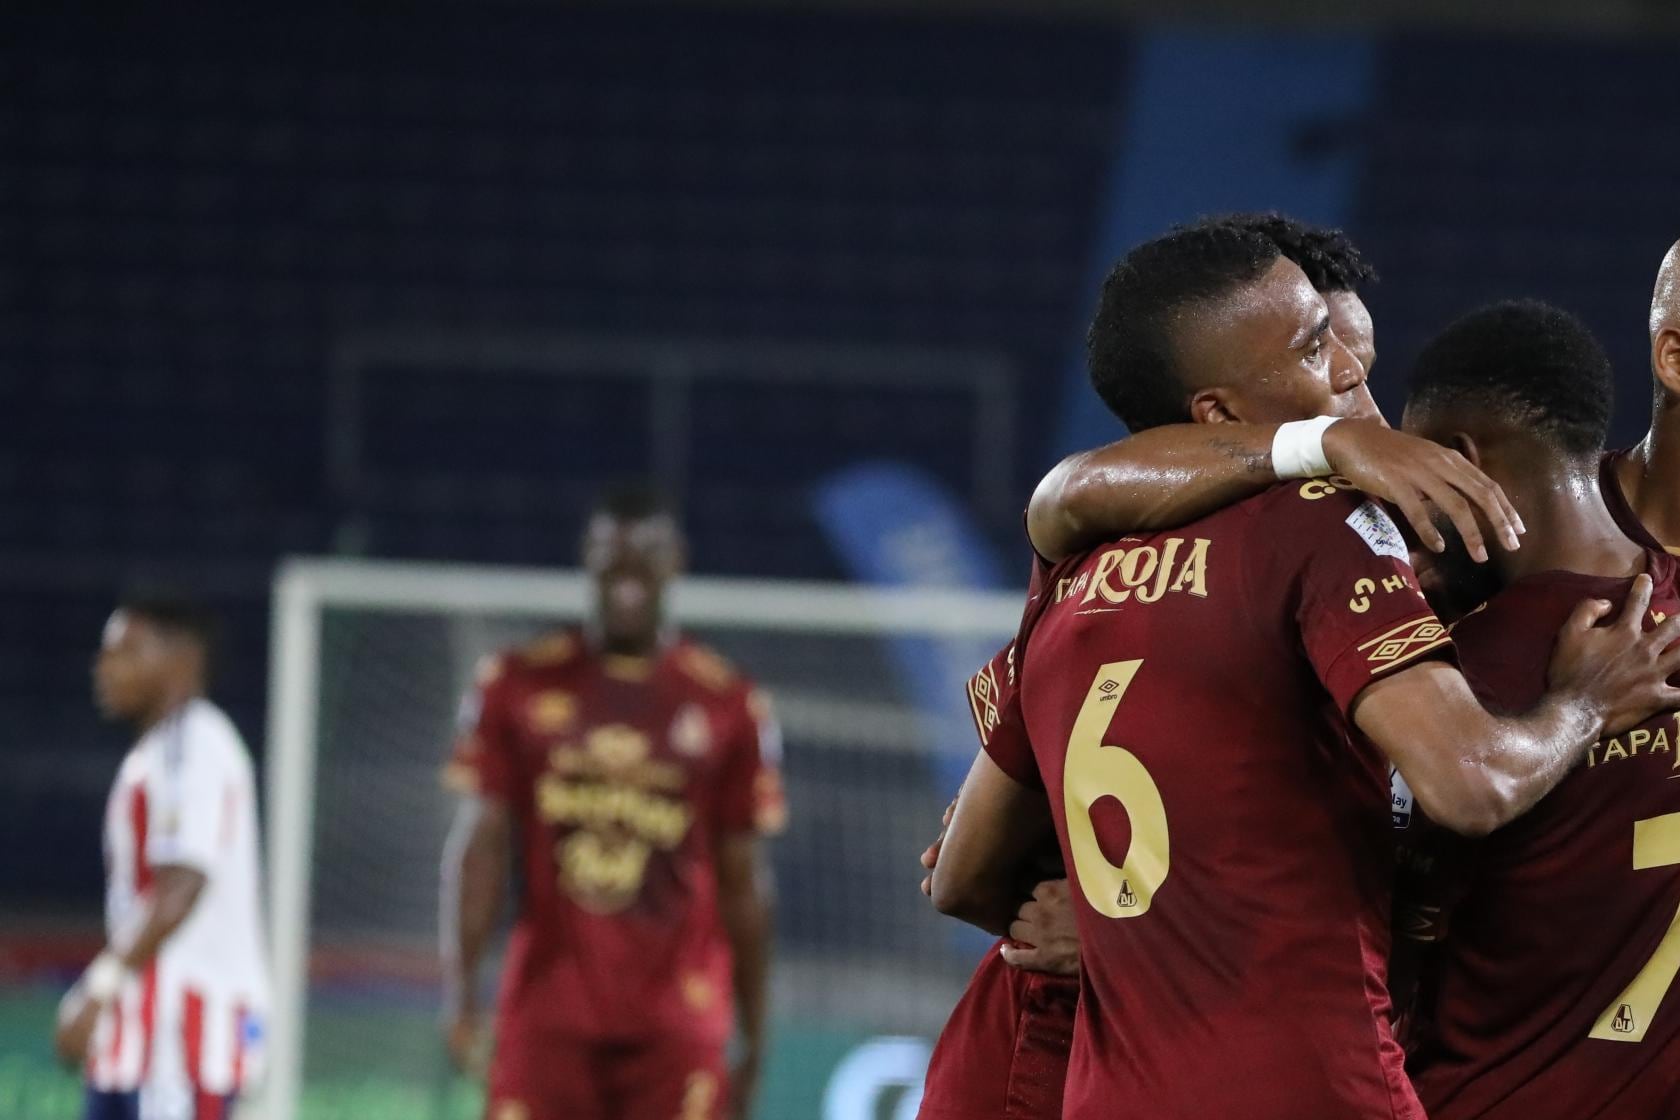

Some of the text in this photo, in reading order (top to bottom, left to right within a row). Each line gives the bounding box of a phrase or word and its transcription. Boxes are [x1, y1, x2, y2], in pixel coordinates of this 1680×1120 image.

[1079, 537, 1212, 606] ROJA
[1587, 728, 1670, 768] TAPA
[1063, 658, 1170, 918] 6
